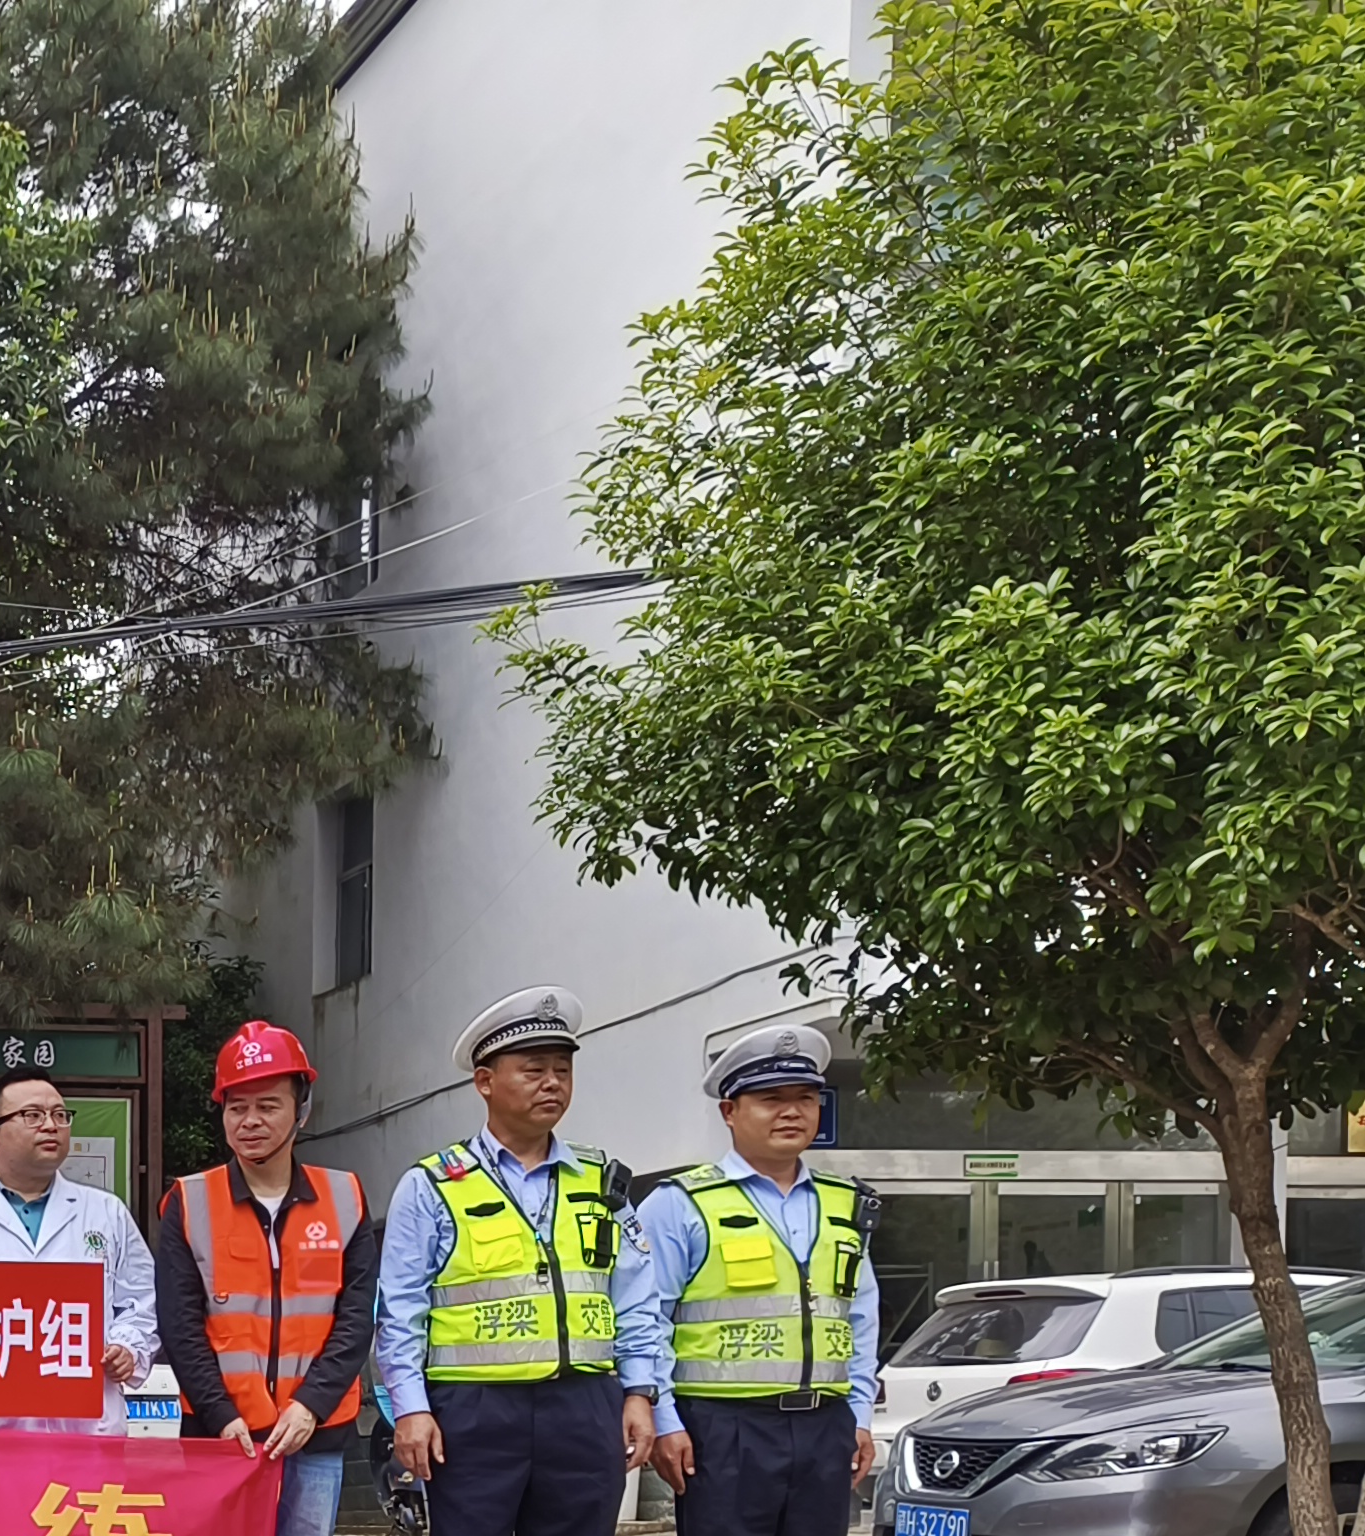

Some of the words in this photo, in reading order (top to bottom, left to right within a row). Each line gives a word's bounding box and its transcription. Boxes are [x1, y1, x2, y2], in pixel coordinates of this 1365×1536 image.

[474, 1300, 539, 1339] 浮梁
[718, 1323, 784, 1358] 浮梁
[127, 1401, 178, 1418] 77KJ7
